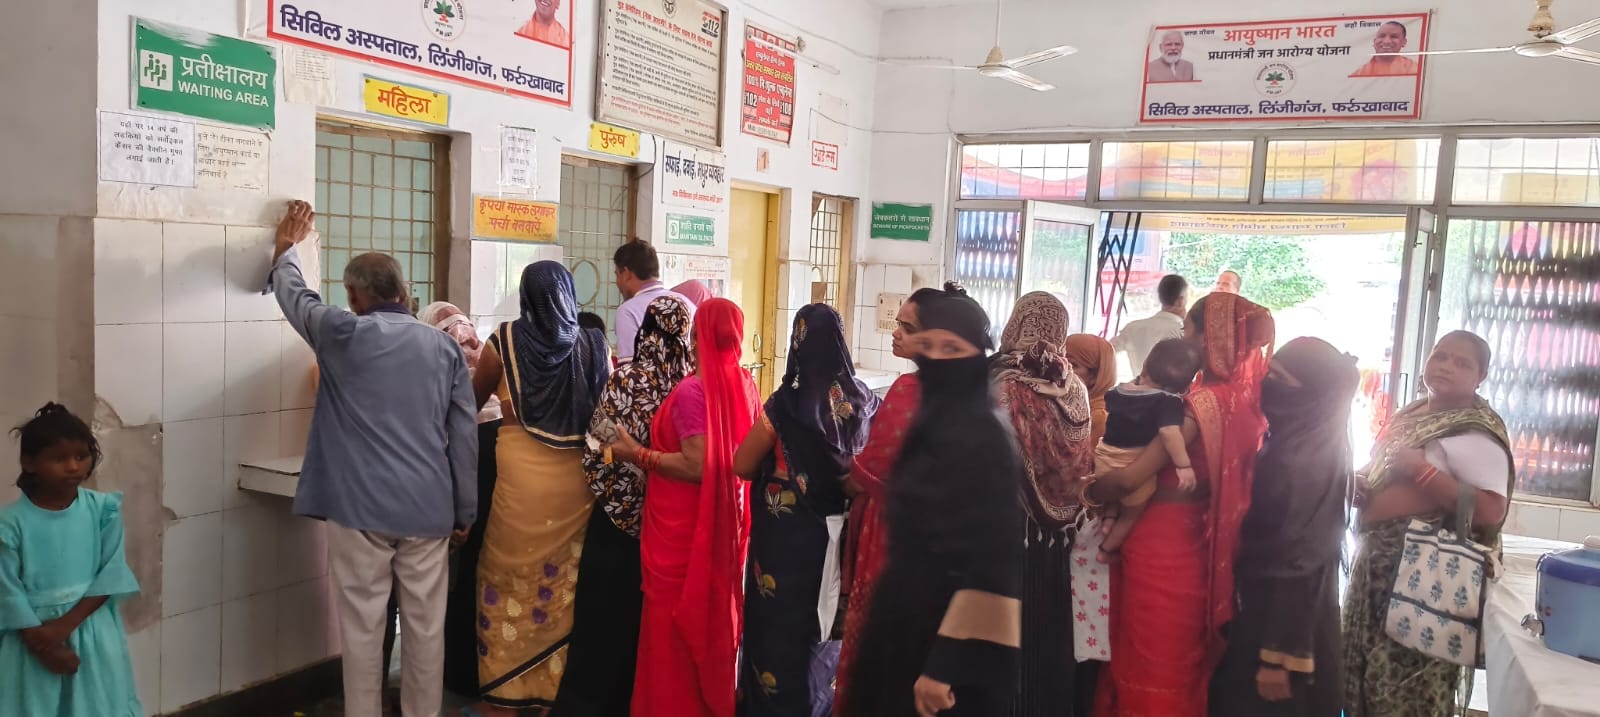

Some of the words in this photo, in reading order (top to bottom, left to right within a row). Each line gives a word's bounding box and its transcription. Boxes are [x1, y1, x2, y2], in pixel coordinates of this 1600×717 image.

[707, 20, 719, 33] 112
[1224, 27, 1292, 46] आयुष्मान
[1296, 25, 1337, 39] भारत
[280, 4, 342, 41] सिविल
[346, 28, 422, 62] अस्पताल,
[428, 43, 496, 80] लिंजीगंज,
[502, 66, 564, 95] फर्रुखाबाद
[1208, 47, 1254, 61] प्रधानमंत्री
[1257, 48, 1273, 59] जन
[1277, 45, 1313, 58] आरोग्य
[1317, 44, 1351, 57] योजना
[180, 54, 268, 89] प्रतीक्षालय
[178, 80, 232, 100] WAITING
[235, 91, 269, 107] AREA
[378, 85, 432, 115] महिला
[746, 92, 757, 107] 102
[1149, 102, 1190, 116] सिविल
[1332, 98, 1410, 112] फर्रुखाबाद
[135, 122, 143, 130] पर
[600, 130, 627, 149] पुरुष
[126, 154, 143, 162] लगाई
[147, 156, 161, 164] जाती
[480, 198, 505, 214] कृपया
[506, 201, 530, 215] मास्क
[489, 214, 511, 231] पर्चा
